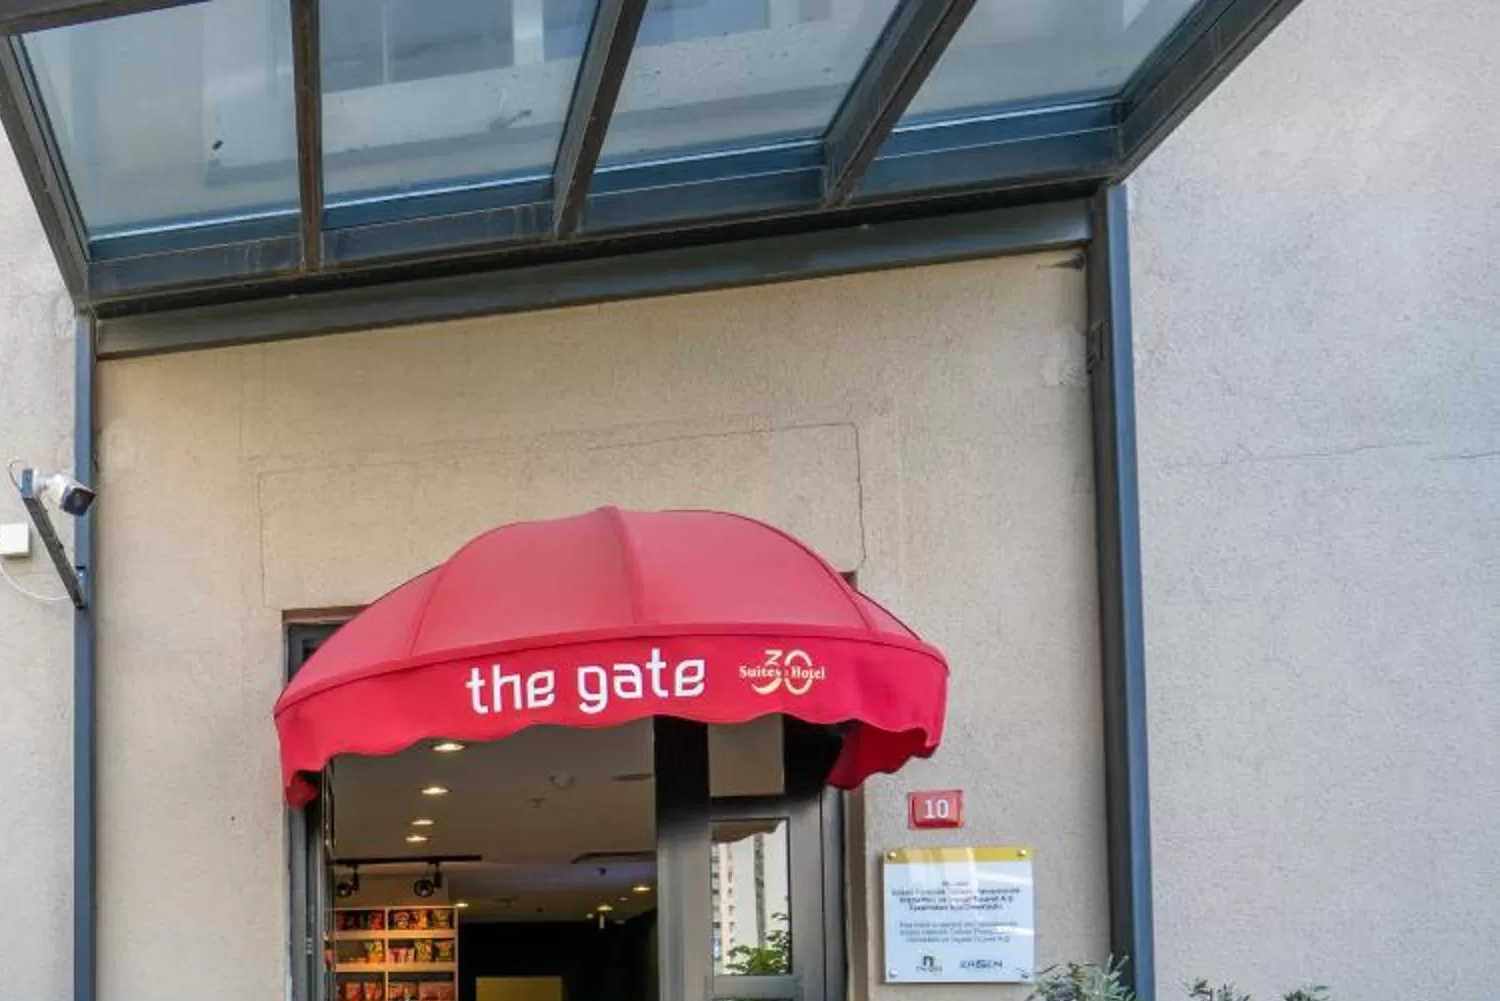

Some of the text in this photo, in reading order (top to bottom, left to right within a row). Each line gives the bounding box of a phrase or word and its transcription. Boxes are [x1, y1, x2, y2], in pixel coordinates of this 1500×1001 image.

[465, 648, 706, 715] the gate
[739, 664, 826, 680] Suites Hotel
[751, 648, 813, 696] 30
[923, 799, 949, 819] 10
